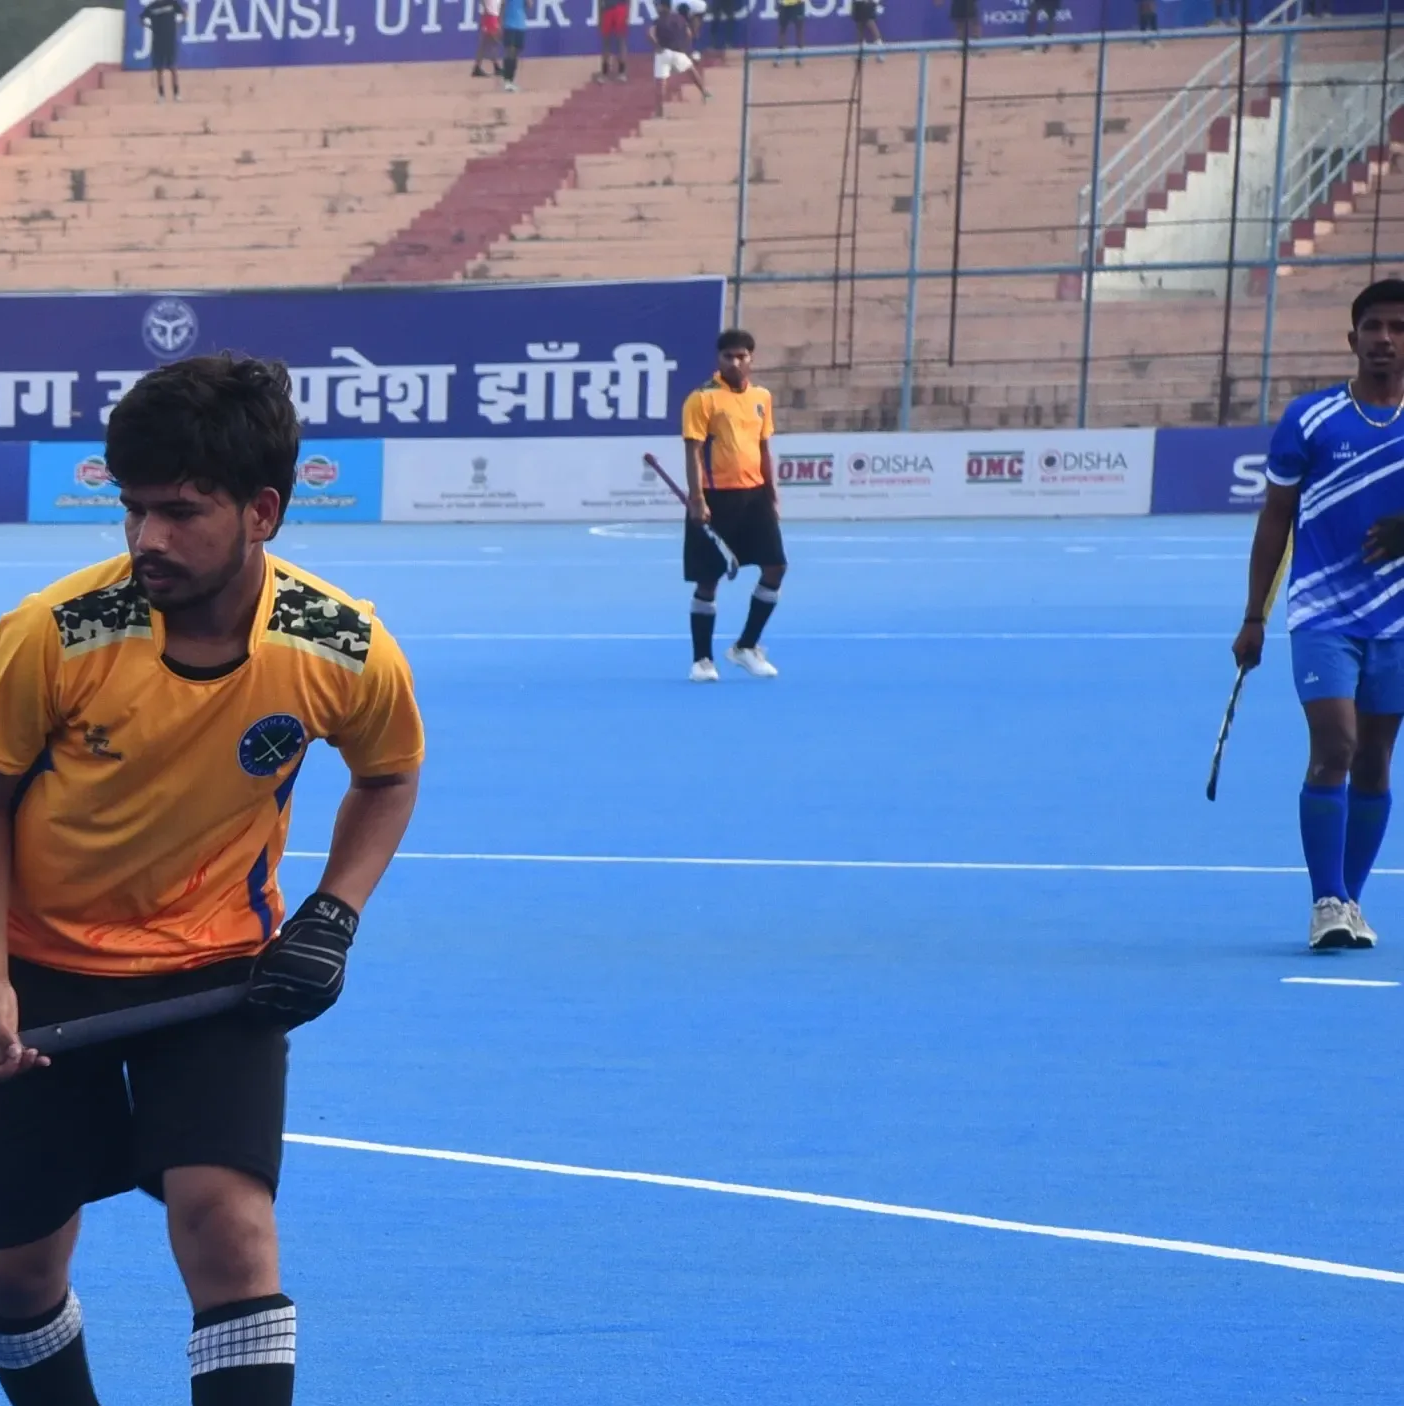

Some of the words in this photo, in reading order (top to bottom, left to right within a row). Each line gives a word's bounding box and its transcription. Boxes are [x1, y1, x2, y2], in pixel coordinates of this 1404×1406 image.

[778, 459, 834, 481] OMC
[848, 452, 935, 476] ODISHA
[966, 456, 1024, 478] OMC
[1039, 449, 1129, 474] ODISHA
